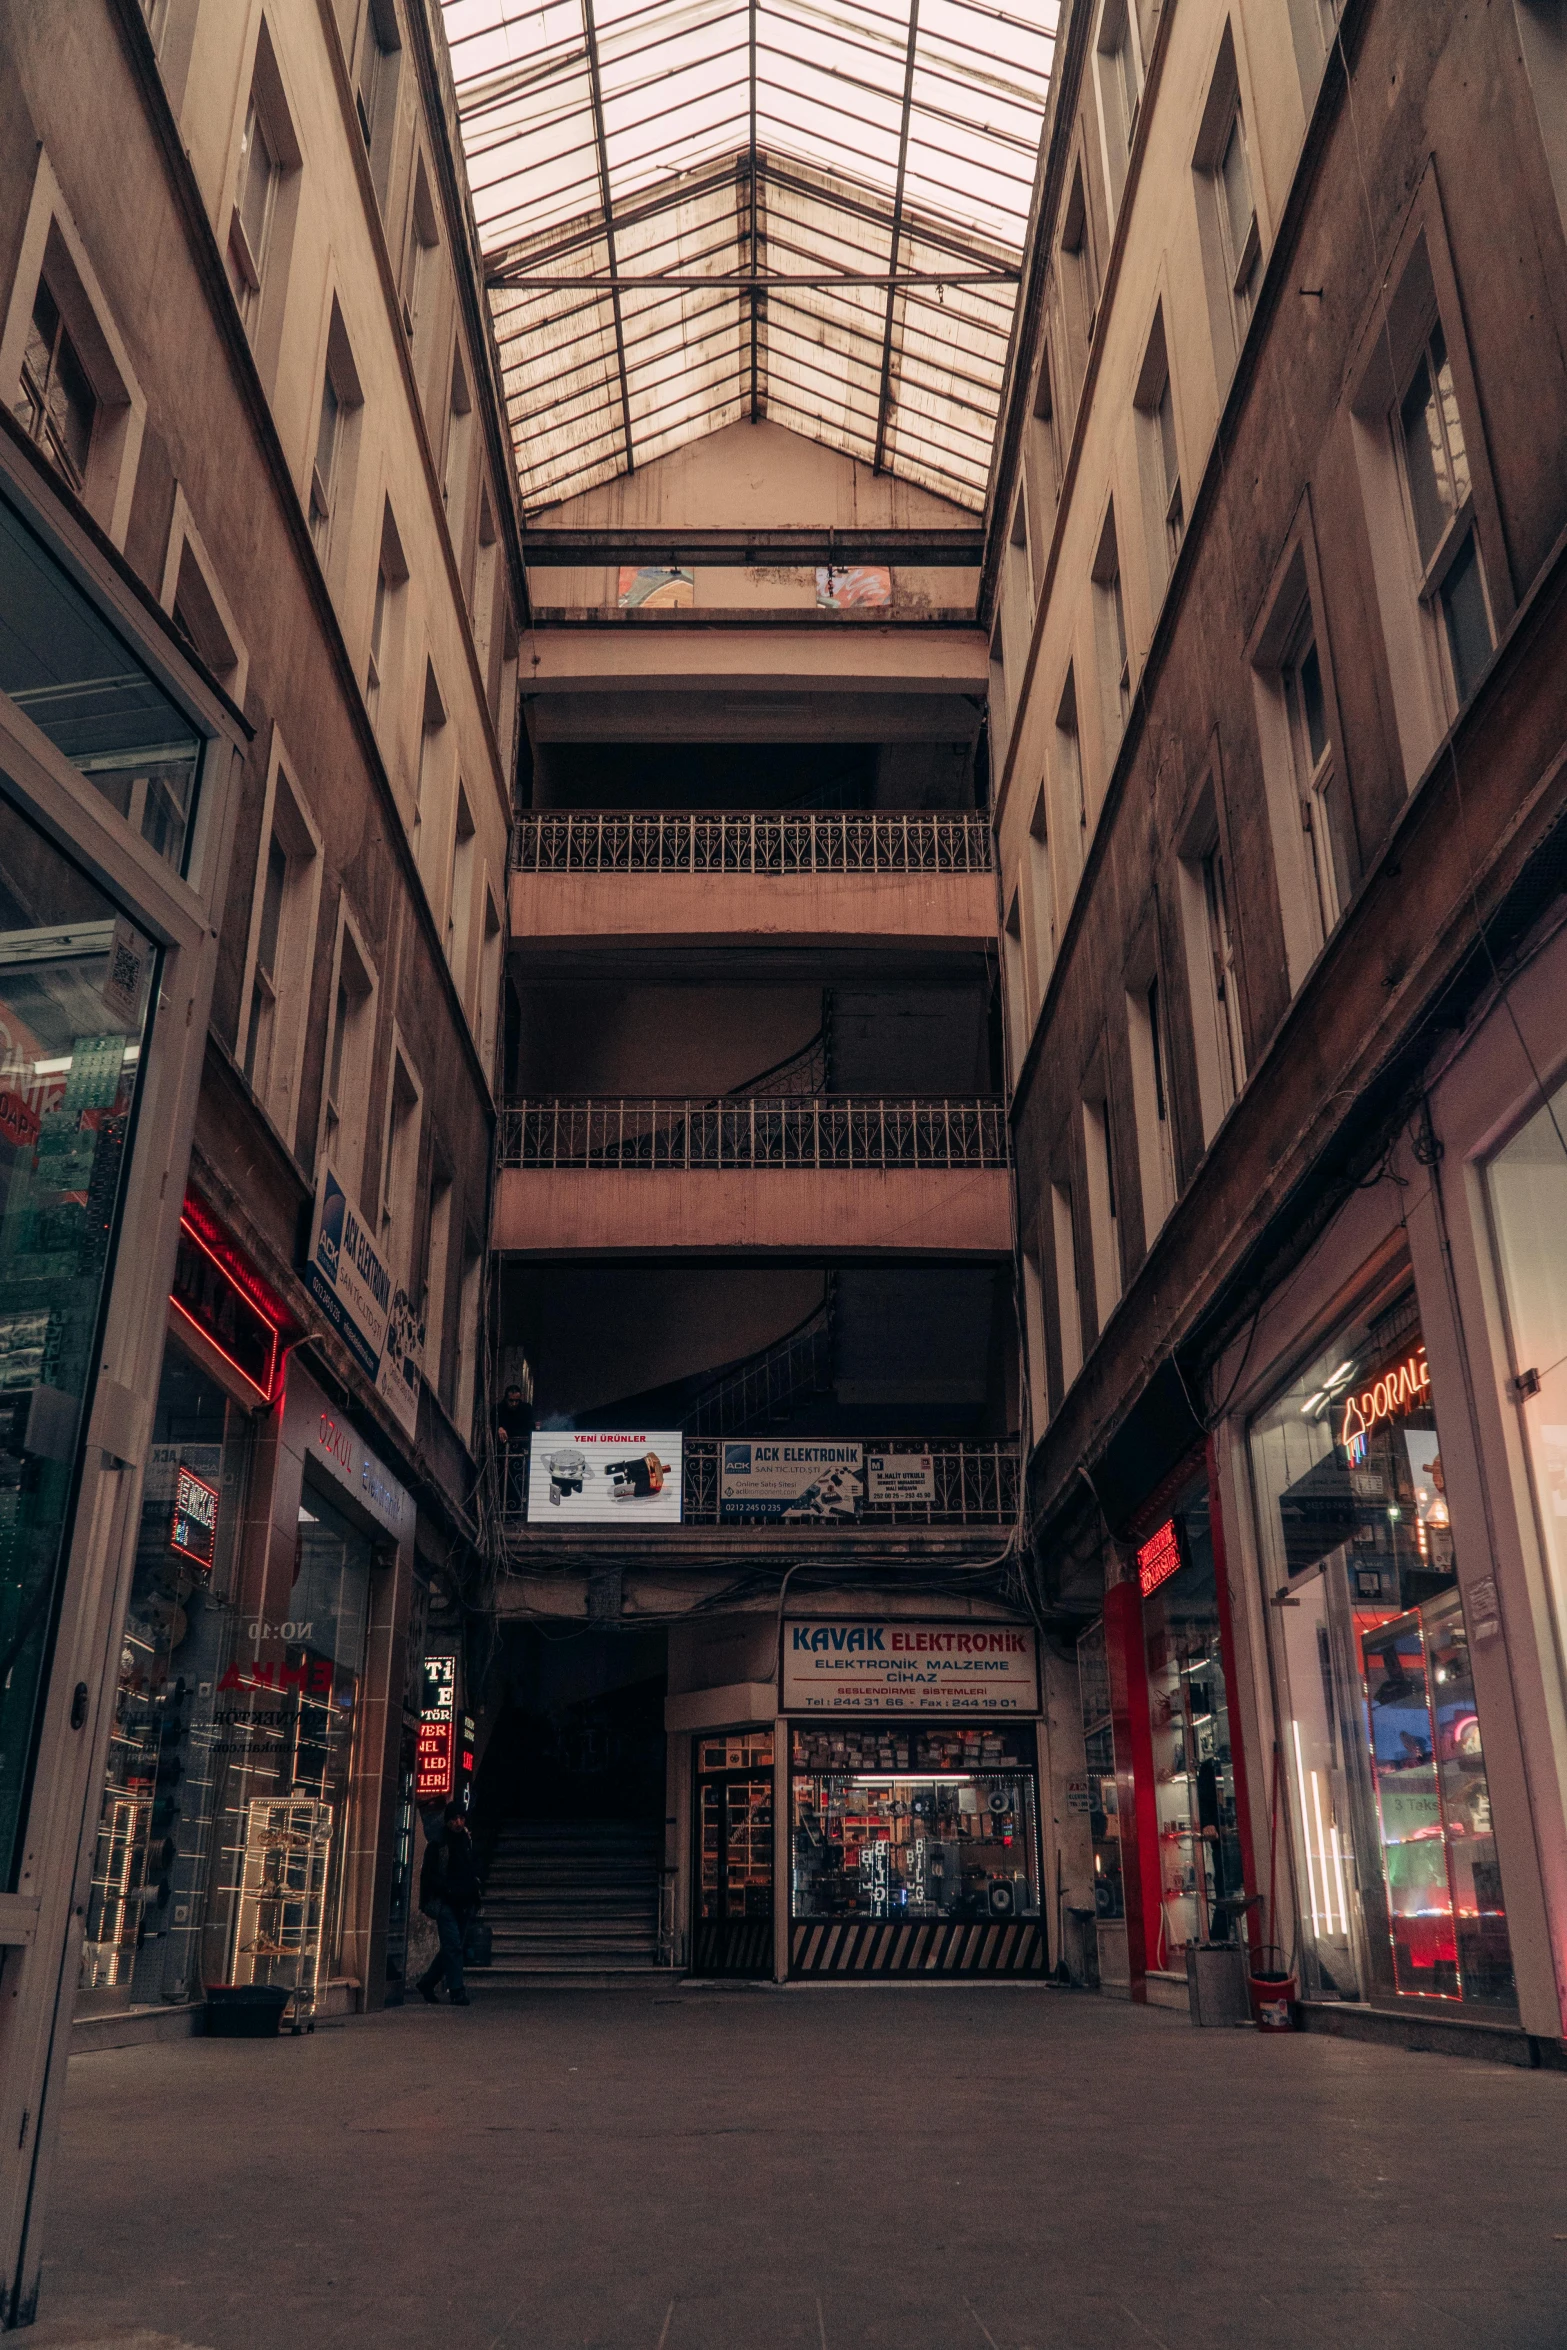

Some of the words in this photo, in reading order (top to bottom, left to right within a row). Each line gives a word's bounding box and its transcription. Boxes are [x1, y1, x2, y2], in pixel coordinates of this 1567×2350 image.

[344, 1211, 359, 1264] ACK
[319, 1229, 339, 1269] ACK
[574, 1434, 597, 1443] YENİ
[600, 1434, 646, 1443] ÜRÜNLER
[755, 1447, 780, 1461] ACK
[784, 1446, 858, 1462] ELEKTRONİK
[760, 1481, 777, 1489] Satış
[725, 1504, 744, 1512] 0212
[746, 1504, 760, 1512] 245
[767, 1504, 781, 1512] 235
[793, 1627, 886, 1652] KAVAK
[892, 1629, 1027, 1654] ELEKTRONİK
[815, 1658, 919, 1669] ELEKTRONİK
[927, 1661, 1009, 1670] MALZEME
[886, 1671, 938, 1683] CİHAZ
[837, 1687, 916, 1695] SESLENDİRME
[923, 1687, 987, 1695] SİSTEMLERİ
[834, 1697, 861, 1706] 244
[861, 1697, 880, 1706] 31
[886, 1698, 903, 1706] 66
[952, 1698, 981, 1707] 244
[981, 1698, 998, 1707] 19
[1000, 1699, 1017, 1707] 01
[421, 1708, 450, 1721] TÖR
[424, 1758, 447, 1769] LED
